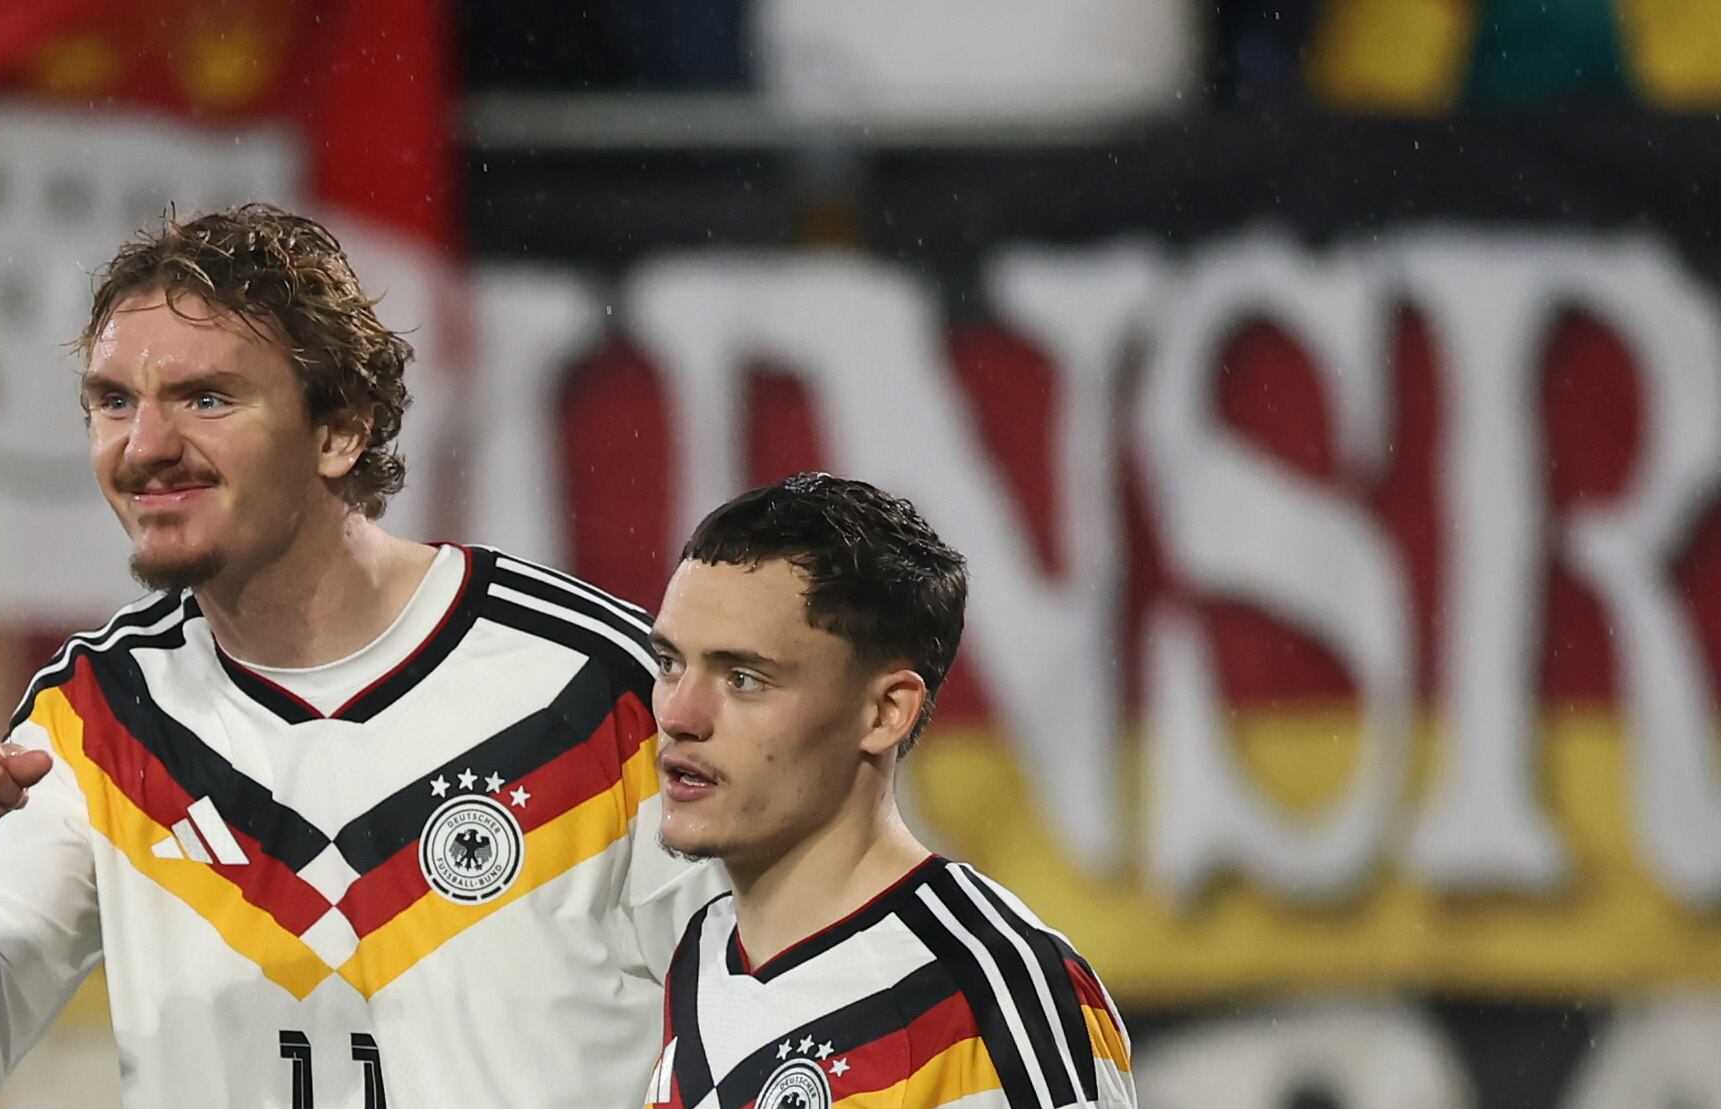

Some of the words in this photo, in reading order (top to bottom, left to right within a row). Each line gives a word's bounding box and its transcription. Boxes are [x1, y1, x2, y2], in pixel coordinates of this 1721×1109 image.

[448, 813, 501, 834] DEUTSCHER
[436, 857, 502, 888] FUSSBALL-BUND
[780, 1076, 817, 1099] DEUTSCHER
